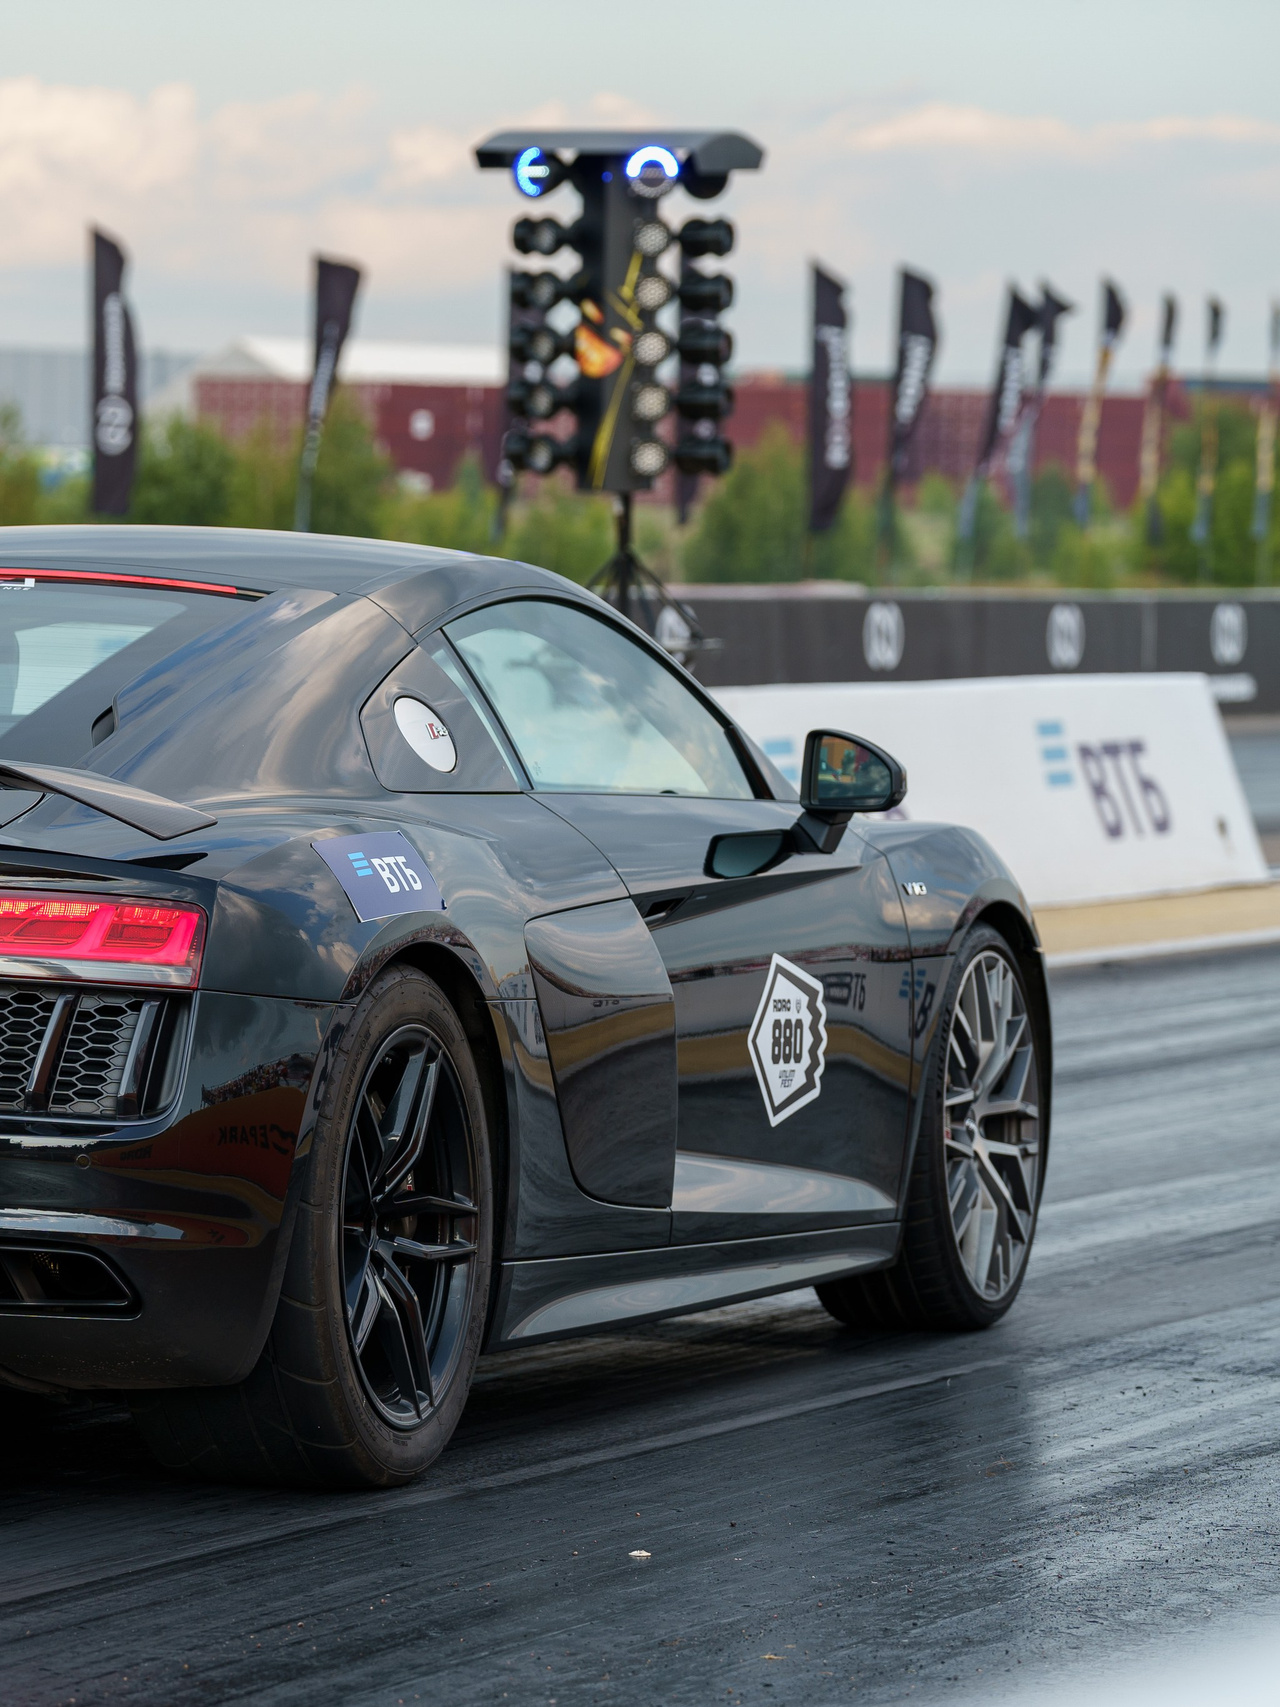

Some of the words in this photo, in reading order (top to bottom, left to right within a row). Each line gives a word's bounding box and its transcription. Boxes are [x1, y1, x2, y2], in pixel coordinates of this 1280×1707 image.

[1078, 742, 1170, 838] ВТБ
[370, 855, 423, 893] ВТБ
[771, 1018, 804, 1065] 880
